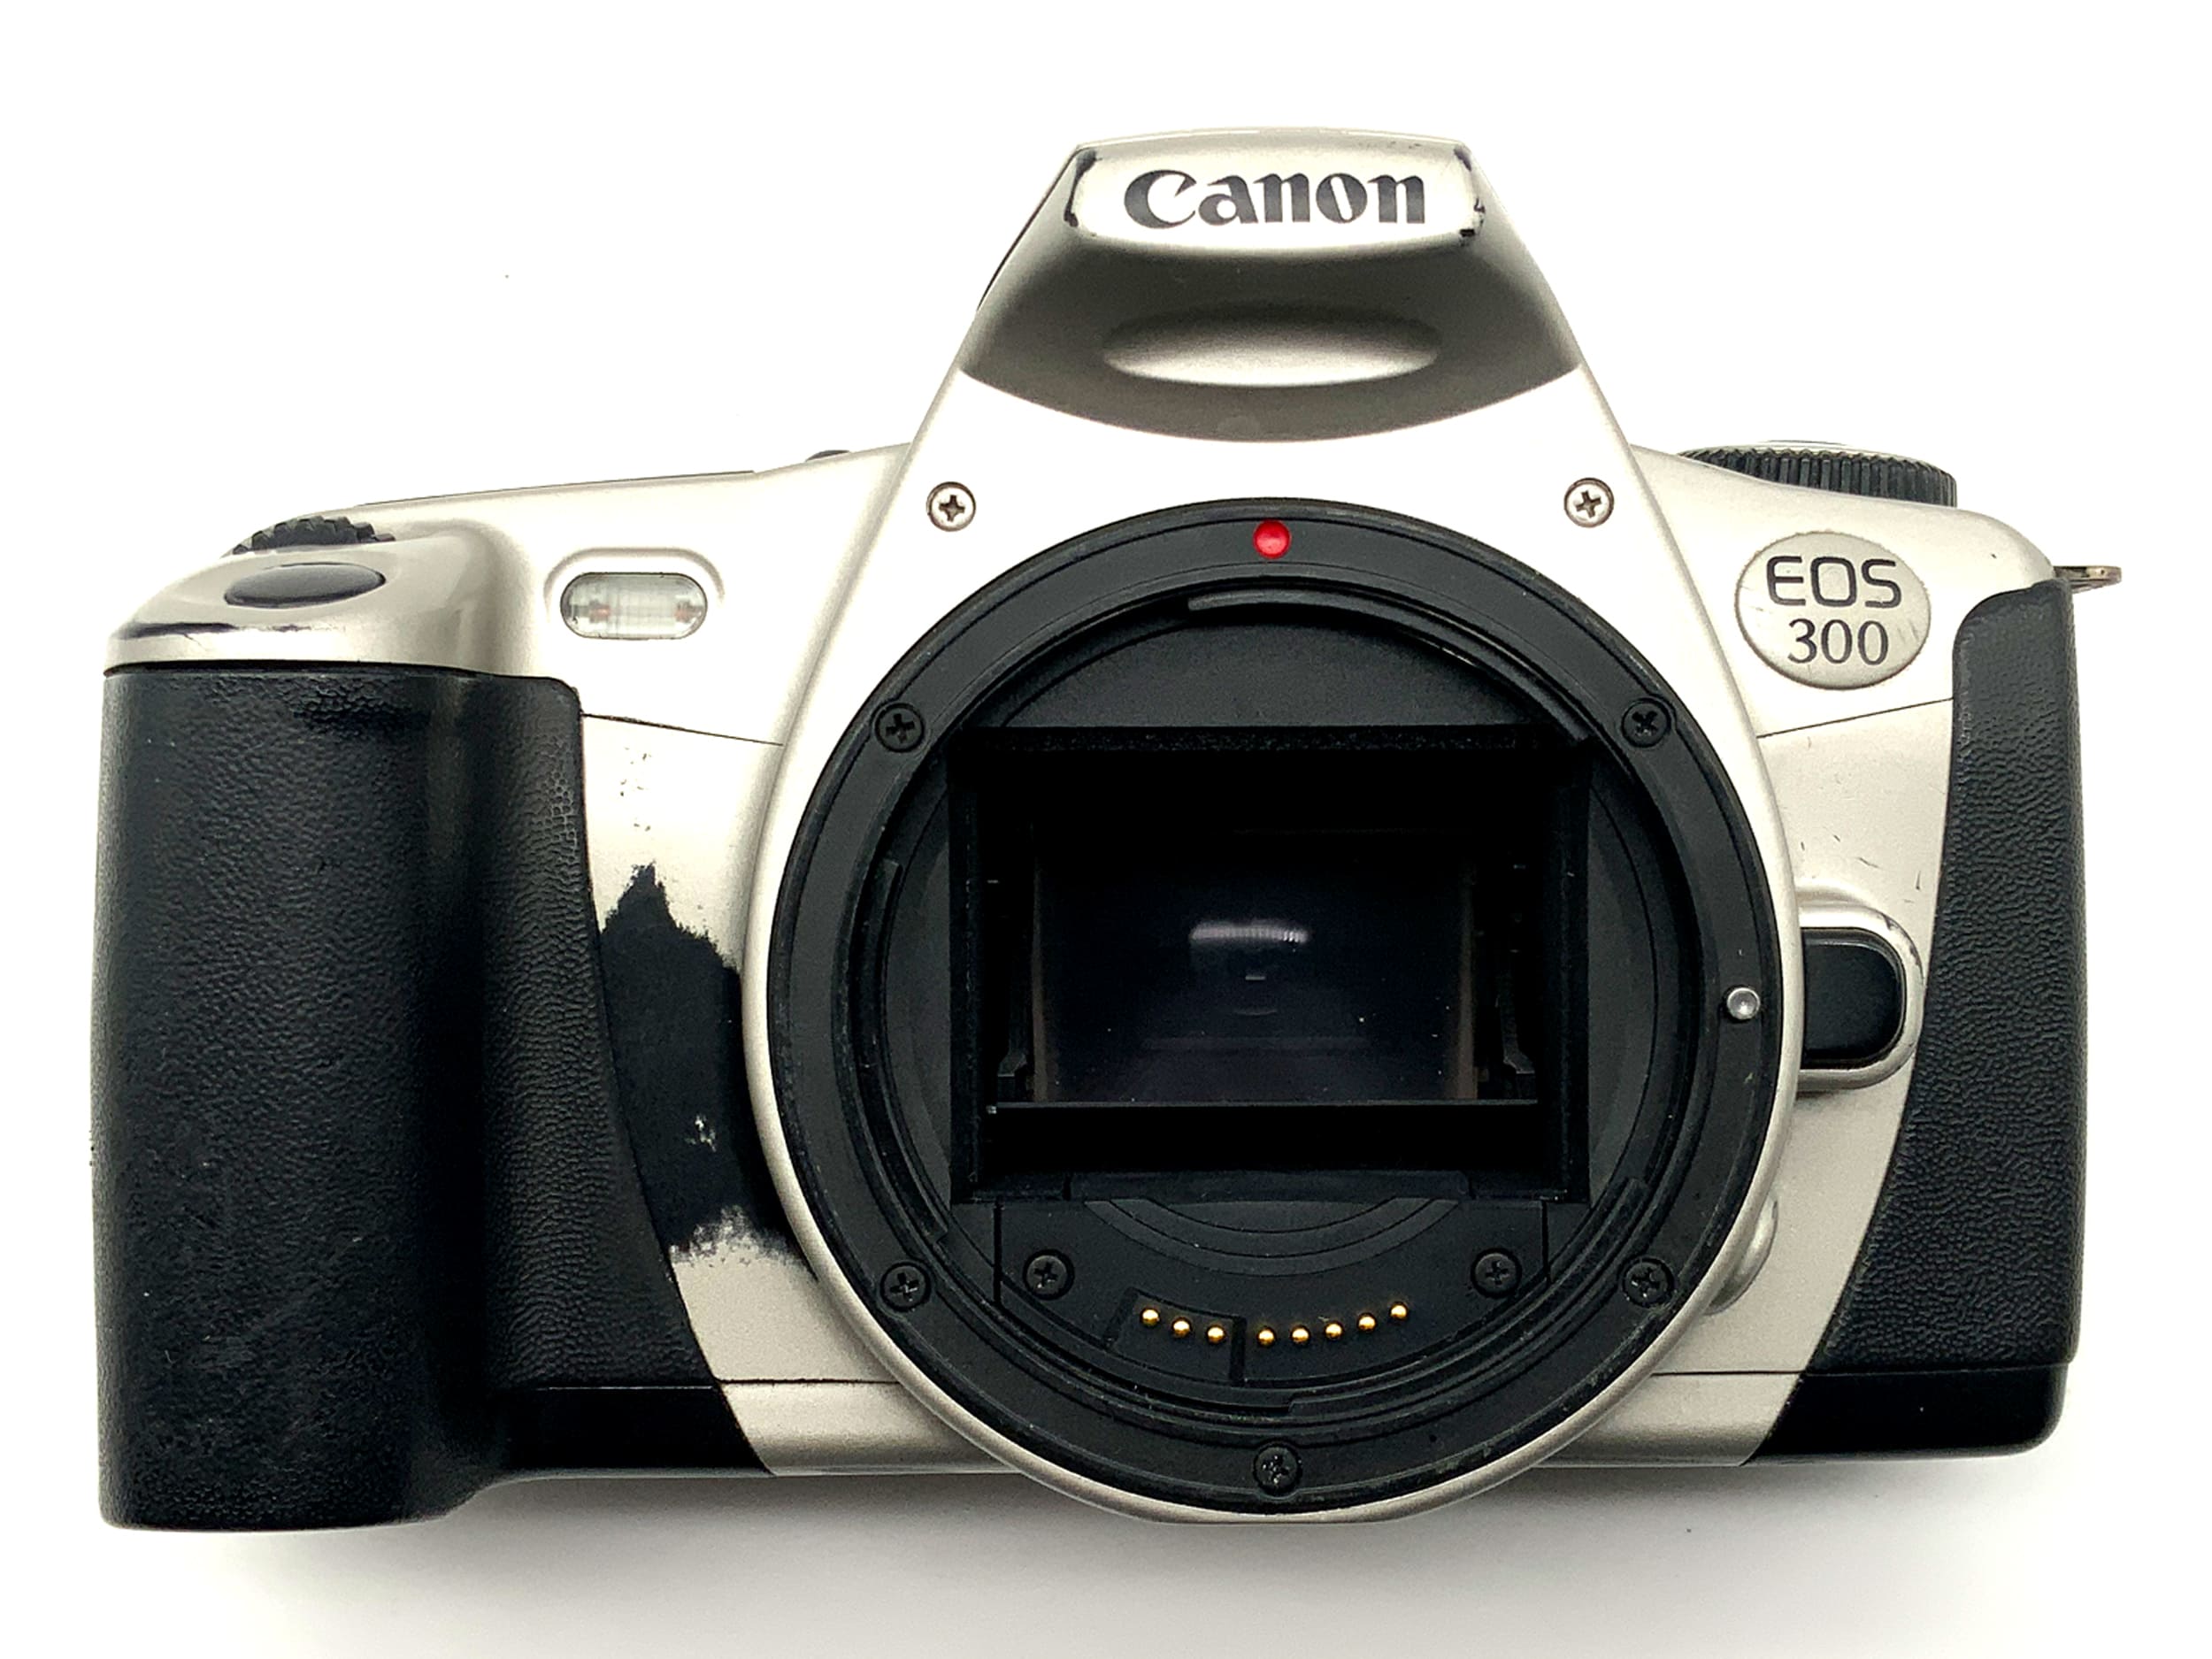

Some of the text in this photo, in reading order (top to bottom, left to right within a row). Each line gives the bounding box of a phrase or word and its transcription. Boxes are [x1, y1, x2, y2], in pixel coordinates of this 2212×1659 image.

[1124, 169, 1425, 229] Canon
[1766, 556, 1901, 609] EOS
[1787, 618, 1889, 665] 300
